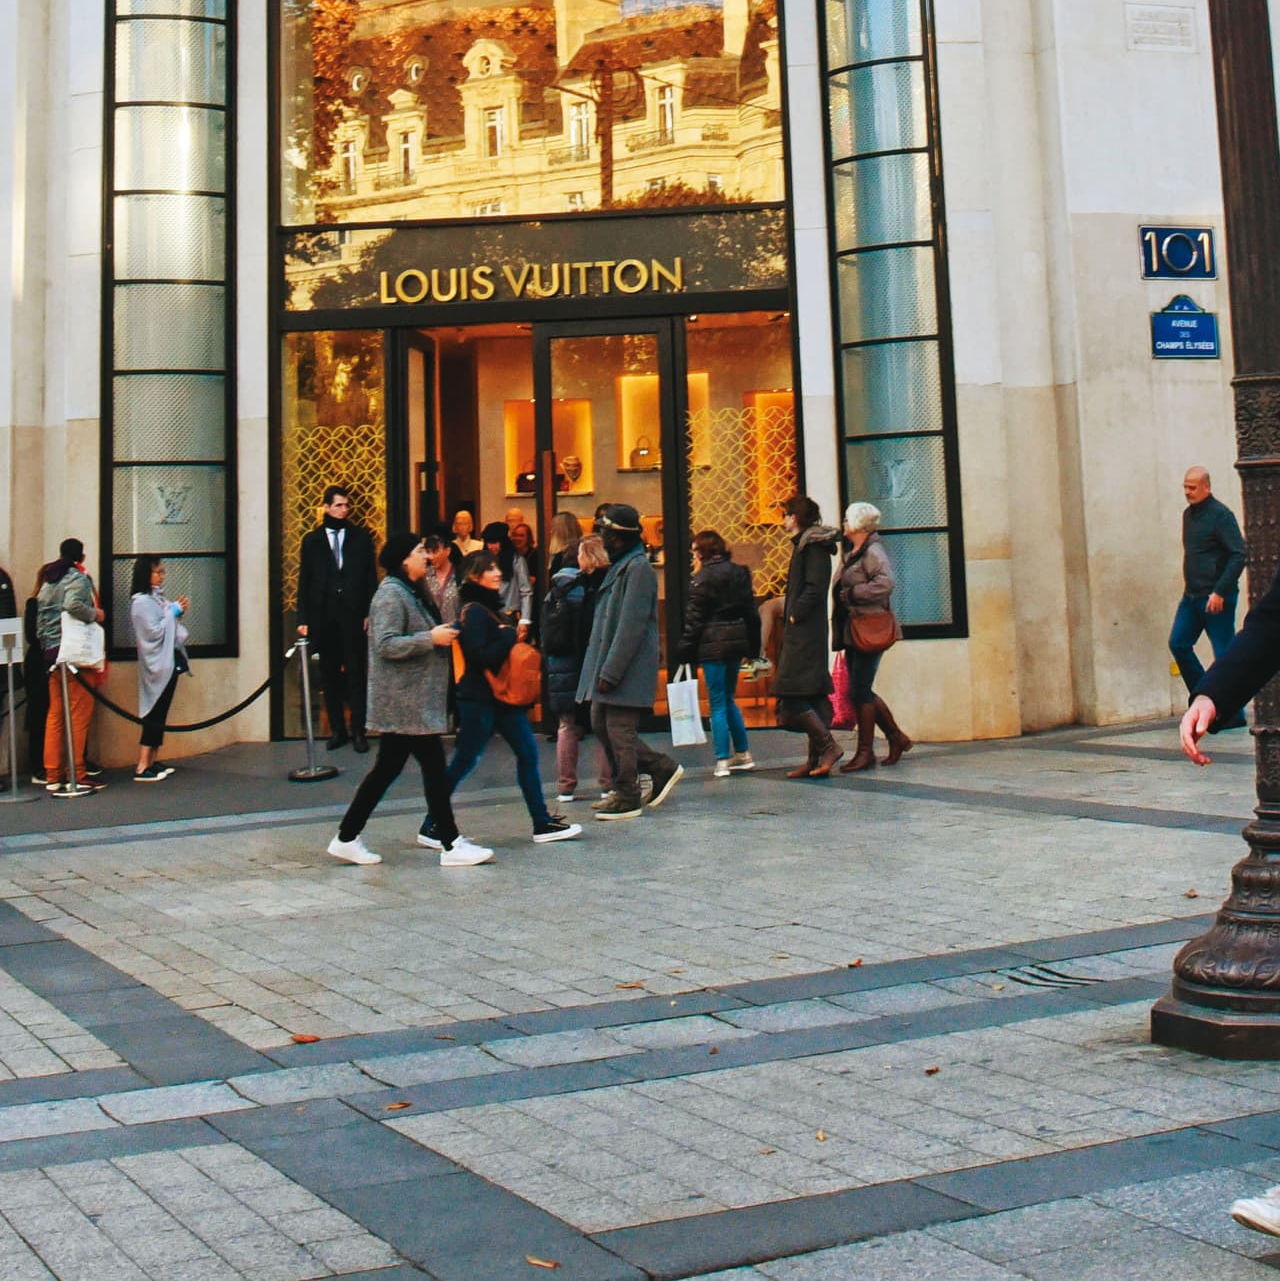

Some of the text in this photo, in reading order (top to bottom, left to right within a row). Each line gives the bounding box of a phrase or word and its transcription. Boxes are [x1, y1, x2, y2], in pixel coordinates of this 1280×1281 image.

[1144, 231, 1211, 273] 101
[380, 257, 685, 304] LOUIS VUITTON
